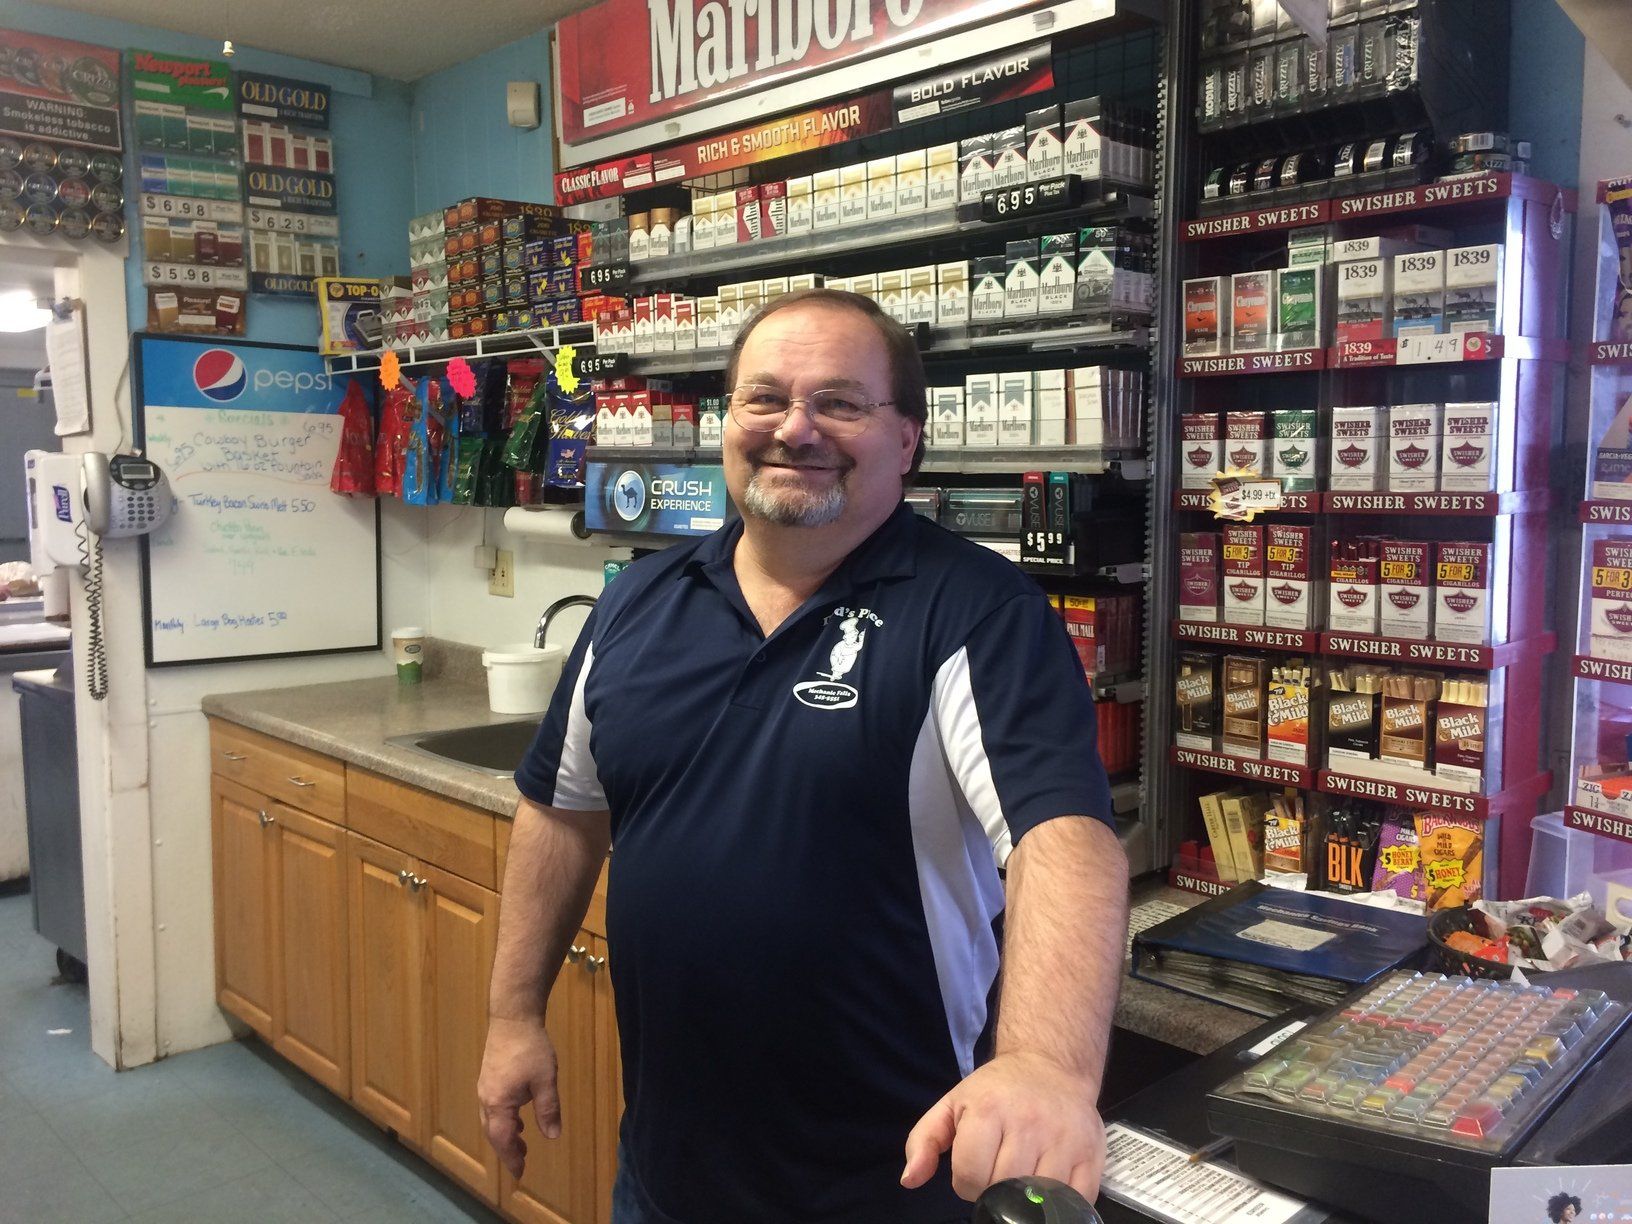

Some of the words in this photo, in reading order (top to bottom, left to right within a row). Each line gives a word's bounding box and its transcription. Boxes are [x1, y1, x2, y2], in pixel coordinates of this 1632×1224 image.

[134, 53, 211, 78] Newport
[911, 79, 954, 102] BOLD
[961, 58, 1030, 88] FLAVOR
[241, 80, 277, 103] OLD
[278, 91, 327, 111] GOLD
[697, 143, 728, 164] RICH
[731, 139, 740, 153] &
[743, 123, 800, 153] SMOOTH
[803, 104, 861, 138] FLAVOR
[1029, 150, 1061, 171] Marlboro
[1066, 142, 1099, 163] Marlboro
[250, 171, 284, 193] OLD
[286, 176, 332, 199] GOLD
[561, 176, 592, 193] CLASSIC
[591, 167, 619, 185] FLAVOR
[994, 165, 1025, 189] Marlboro
[1341, 190, 1416, 214] SWISHER
[1425, 178, 1498, 202] SWEETS
[1187, 215, 1251, 237] SWISHER
[1258, 205, 1319, 227] SWEETS
[1344, 240, 1370, 254] 1839
[1401, 256, 1436, 273] 1839
[1453, 249, 1491, 267] 1839
[1344, 264, 1378, 280] 1839
[264, 278, 287, 290] OLD
[1007, 281, 1037, 298] Marlboro
[1041, 276, 1072, 295] Marlboro
[1344, 342, 1372, 355] 1839
[1184, 357, 1246, 373] SWISHER
[1253, 352, 1313, 369] SWEETS
[253, 367, 334, 394] pepsi
[1228, 424, 1260, 432] SWISHER
[1392, 418, 1432, 428] SWISHER
[1447, 417, 1489, 426] SWISHER
[1449, 425, 1486, 434] SWEETS
[1229, 431, 1259, 439] SWEETS
[1394, 427, 1429, 436] SWEETS
[254, 433, 313, 455] Burger
[651, 480, 712, 496] CRUSH
[1241, 489, 1263, 501] $4.99
[650, 498, 712, 512] EXPERIENCE
[1333, 495, 1406, 510] SWISHER
[1414, 495, 1485, 510] SWEETS
[1272, 531, 1304, 540] SWISHER
[1274, 538, 1303, 546] SWEETS
[1384, 546, 1423, 556] SWISHER
[1386, 554, 1421, 562] SWEETS
[1442, 547, 1483, 557] SWISHER
[1443, 556, 1480, 564] SWEETS
[1226, 568, 1261, 576] CIGARILLOS
[1269, 571, 1306, 579] CIGARILLOS
[1383, 562, 1391, 577] 5
[1391, 564, 1405, 574] FOR
[1405, 564, 1414, 579] 3
[1439, 564, 1448, 578] 5
[1448, 565, 1463, 576] FOR
[1463, 565, 1472, 580] 3
[1179, 624, 1239, 641] SWISHER
[1245, 630, 1303, 647] SWEETS
[1329, 637, 1402, 656] SWISHER
[1410, 644, 1480, 663] SWEETS
[1268, 693, 1309, 711] Black
[1331, 699, 1368, 716] Black
[1280, 704, 1309, 723] Mild
[1342, 709, 1370, 726] Mild
[1385, 704, 1420, 720] Black
[1395, 714, 1422, 729] Mild
[1438, 713, 1480, 730] Black
[1450, 723, 1481, 740] Mild
[1177, 750, 1237, 772] SWISHER
[1243, 762, 1300, 783] SWEETS
[1326, 775, 1398, 800] SWISHER
[1406, 788, 1475, 812] SWEETS
[1266, 826, 1299, 839] Black
[1275, 836, 1300, 849] Mild
[1328, 842, 1364, 888] BLK
[1435, 867, 1461, 879] HONEY
